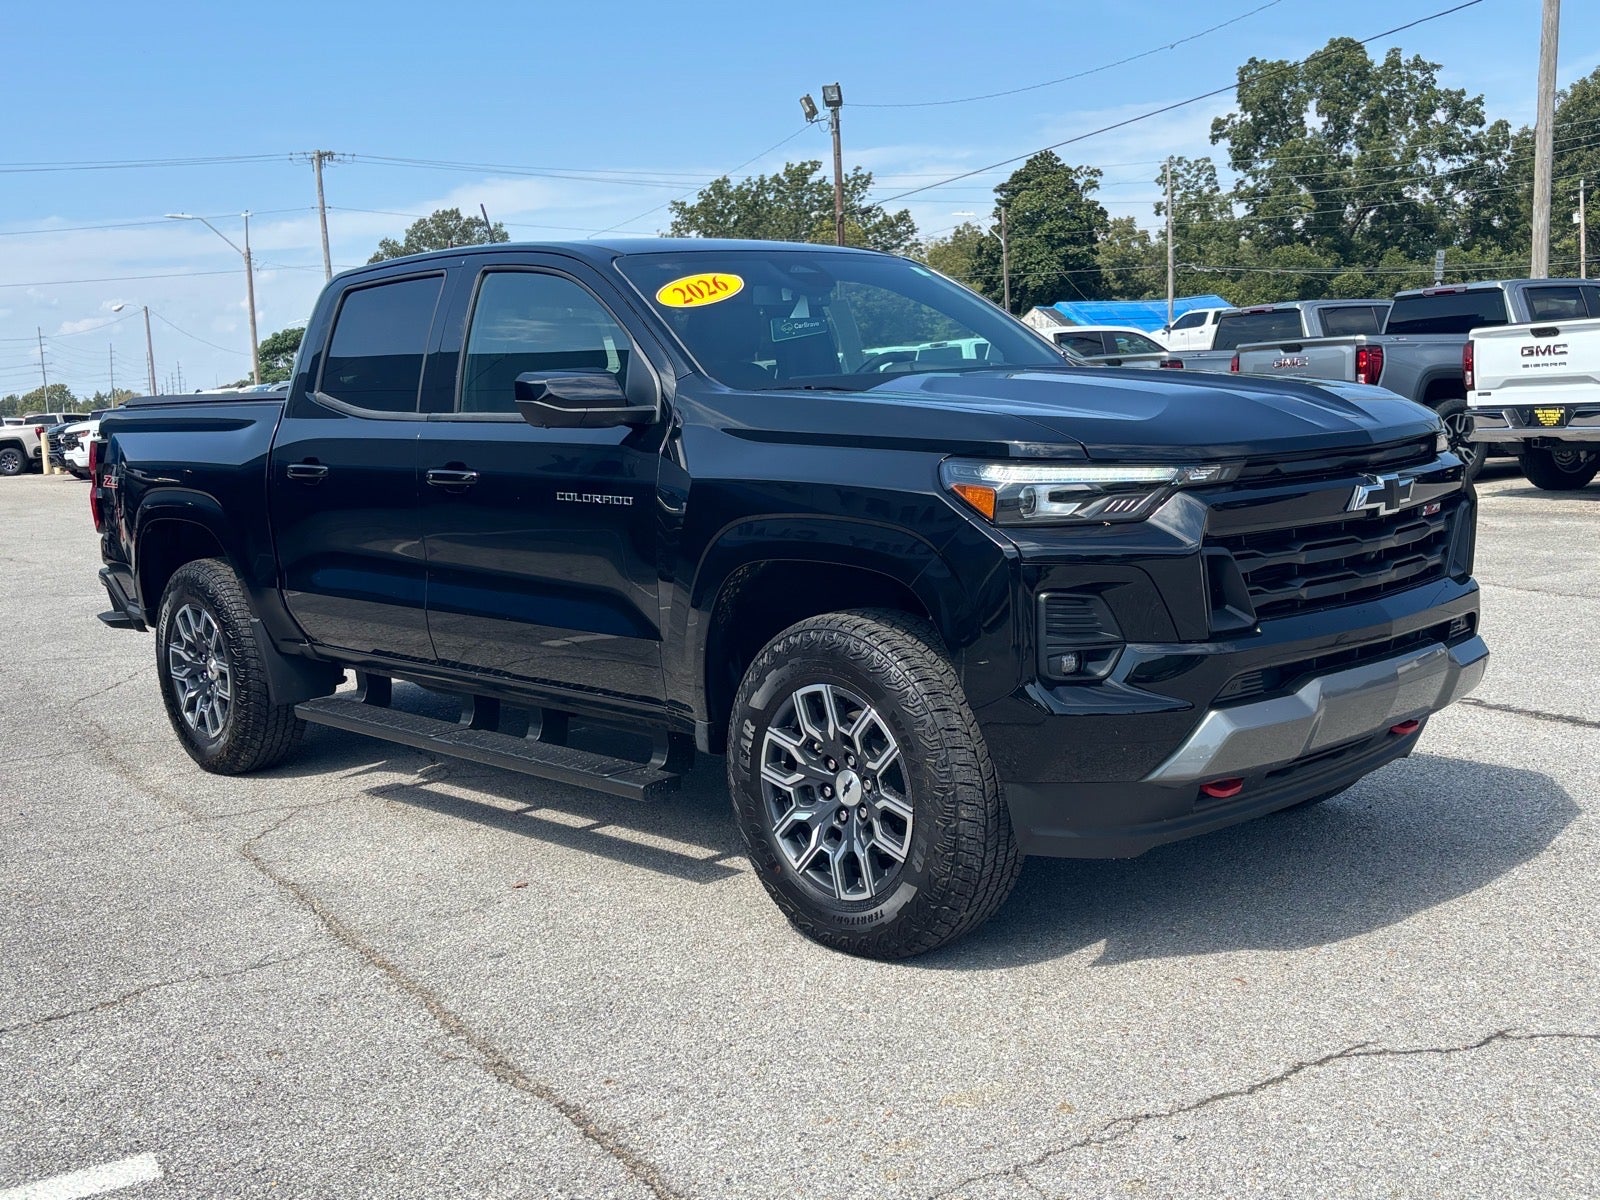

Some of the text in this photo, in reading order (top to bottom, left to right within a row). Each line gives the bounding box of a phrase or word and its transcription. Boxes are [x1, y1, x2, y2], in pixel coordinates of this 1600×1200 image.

[672, 275, 729, 304] 2026
[1520, 343, 1569, 357] GMC
[1272, 356, 1309, 368] GMC
[556, 491, 634, 506] COLORADO
